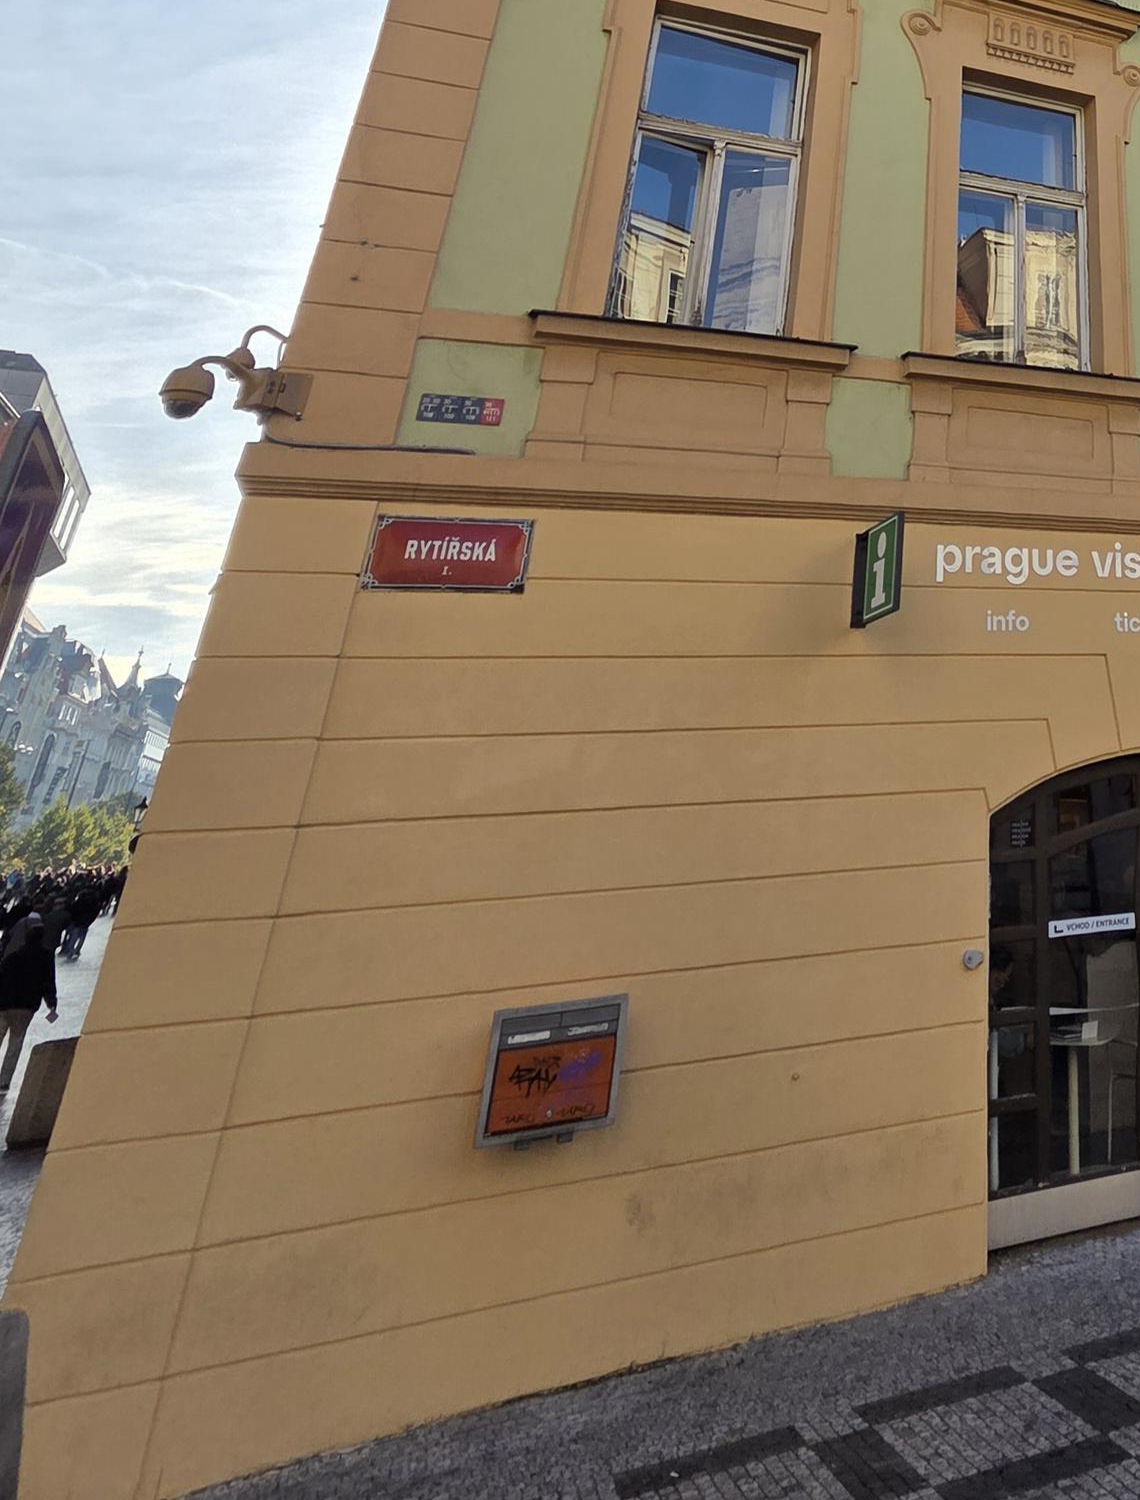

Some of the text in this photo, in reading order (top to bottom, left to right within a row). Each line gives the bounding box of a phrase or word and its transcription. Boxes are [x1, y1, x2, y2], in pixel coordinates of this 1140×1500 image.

[404, 537, 497, 561] RYTÍŘSKÁ
[936, 544, 1079, 585] prague
[986, 610, 1030, 631] info
[1096, 917, 1130, 928] ENTRANCE
